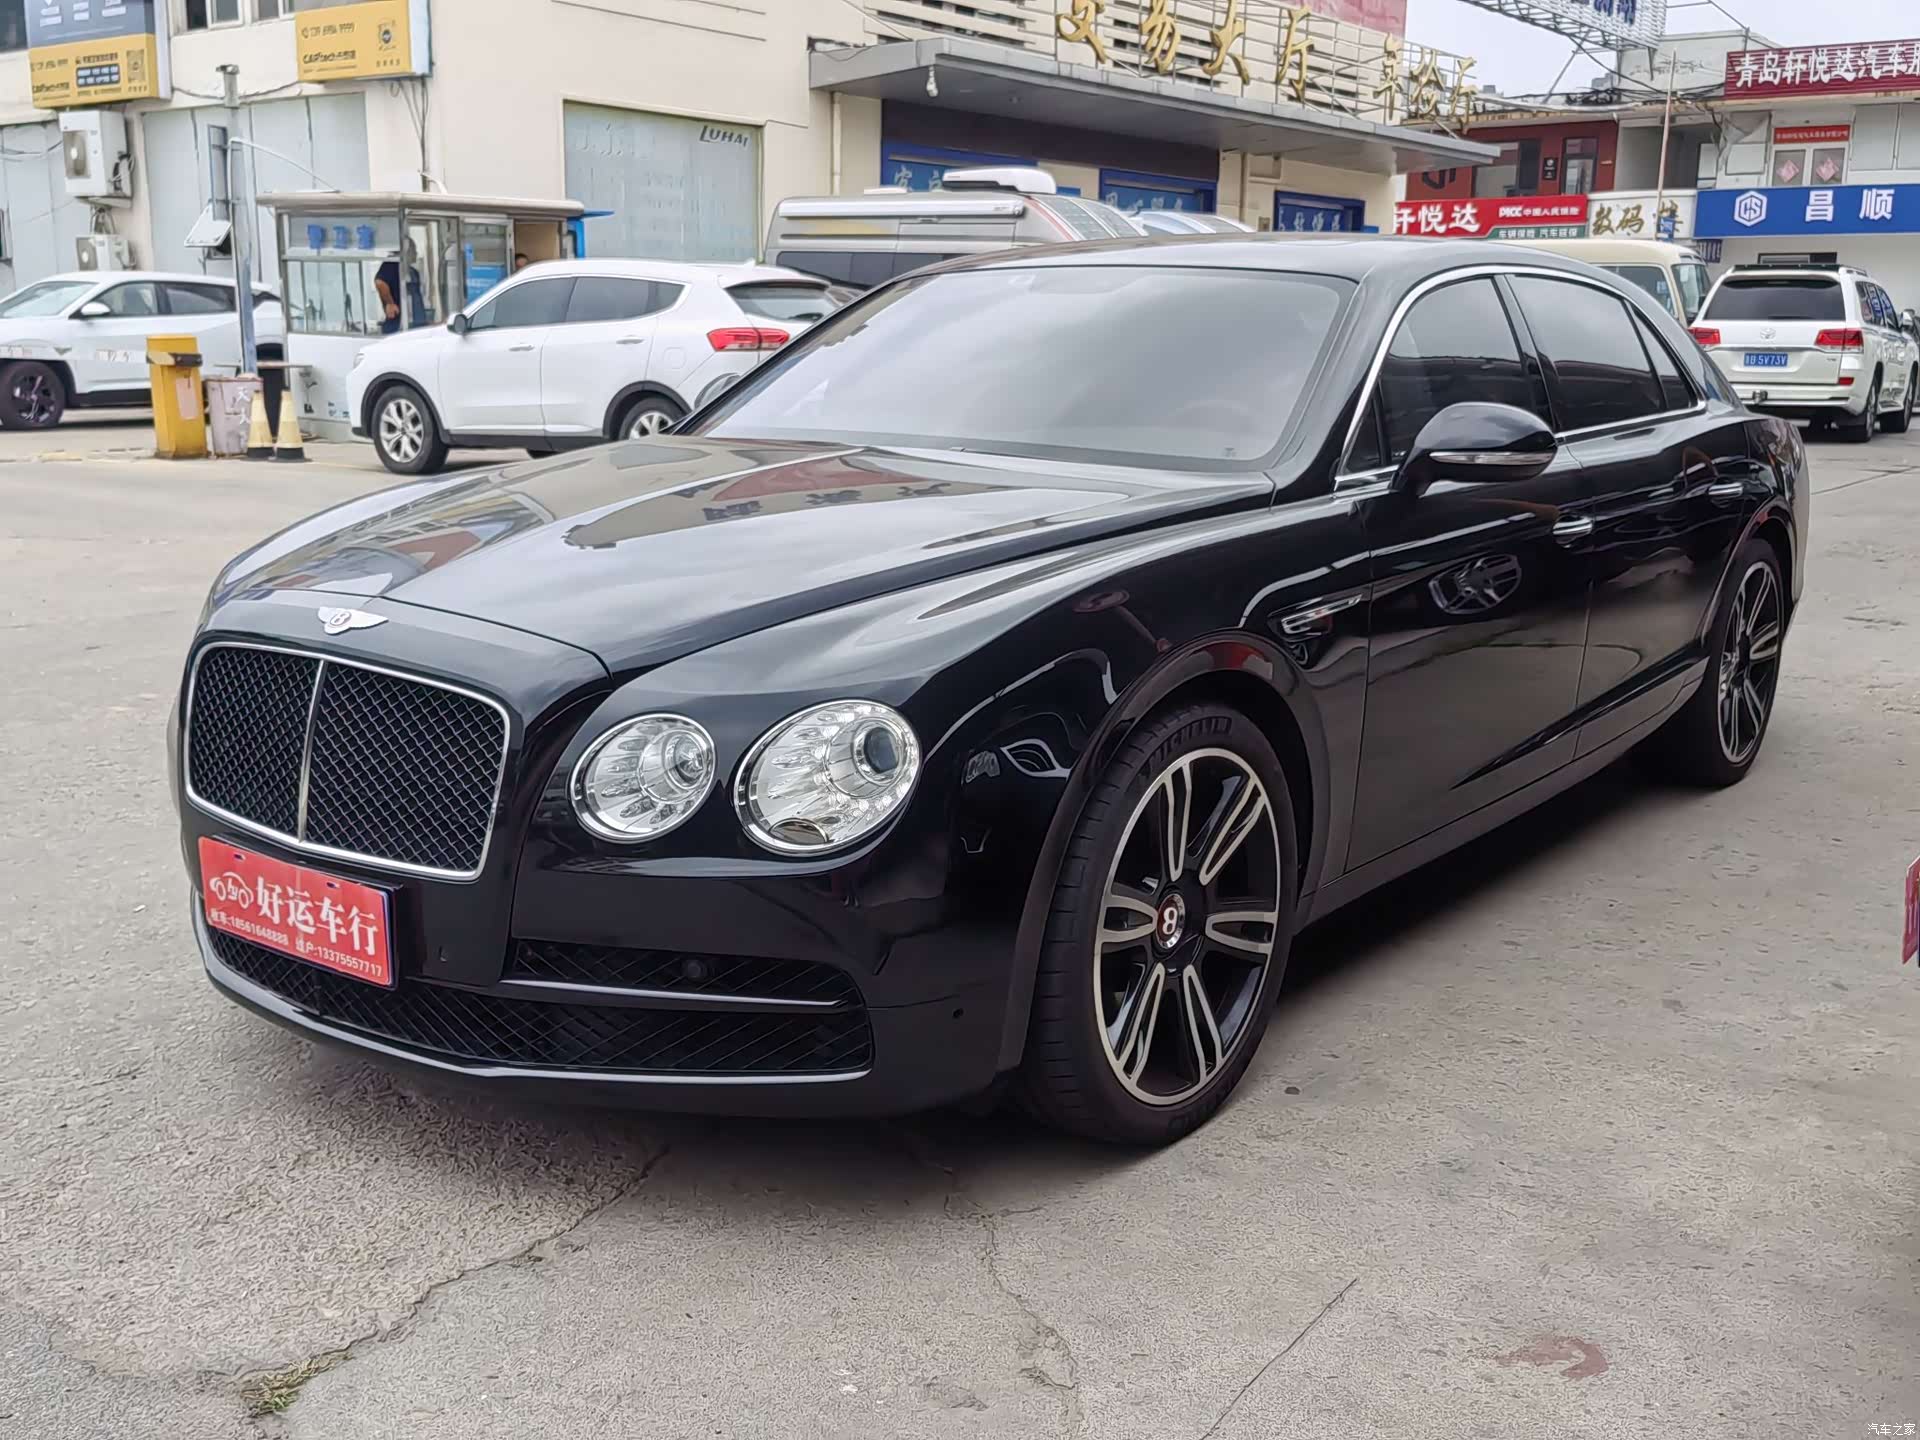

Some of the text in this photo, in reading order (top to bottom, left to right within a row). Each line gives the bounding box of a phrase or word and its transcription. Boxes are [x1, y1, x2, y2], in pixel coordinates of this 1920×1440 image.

[700, 125, 748, 147] LUHAI
[1805, 188, 1895, 222] 昌顺
[256, 875, 378, 956] 好运车行
